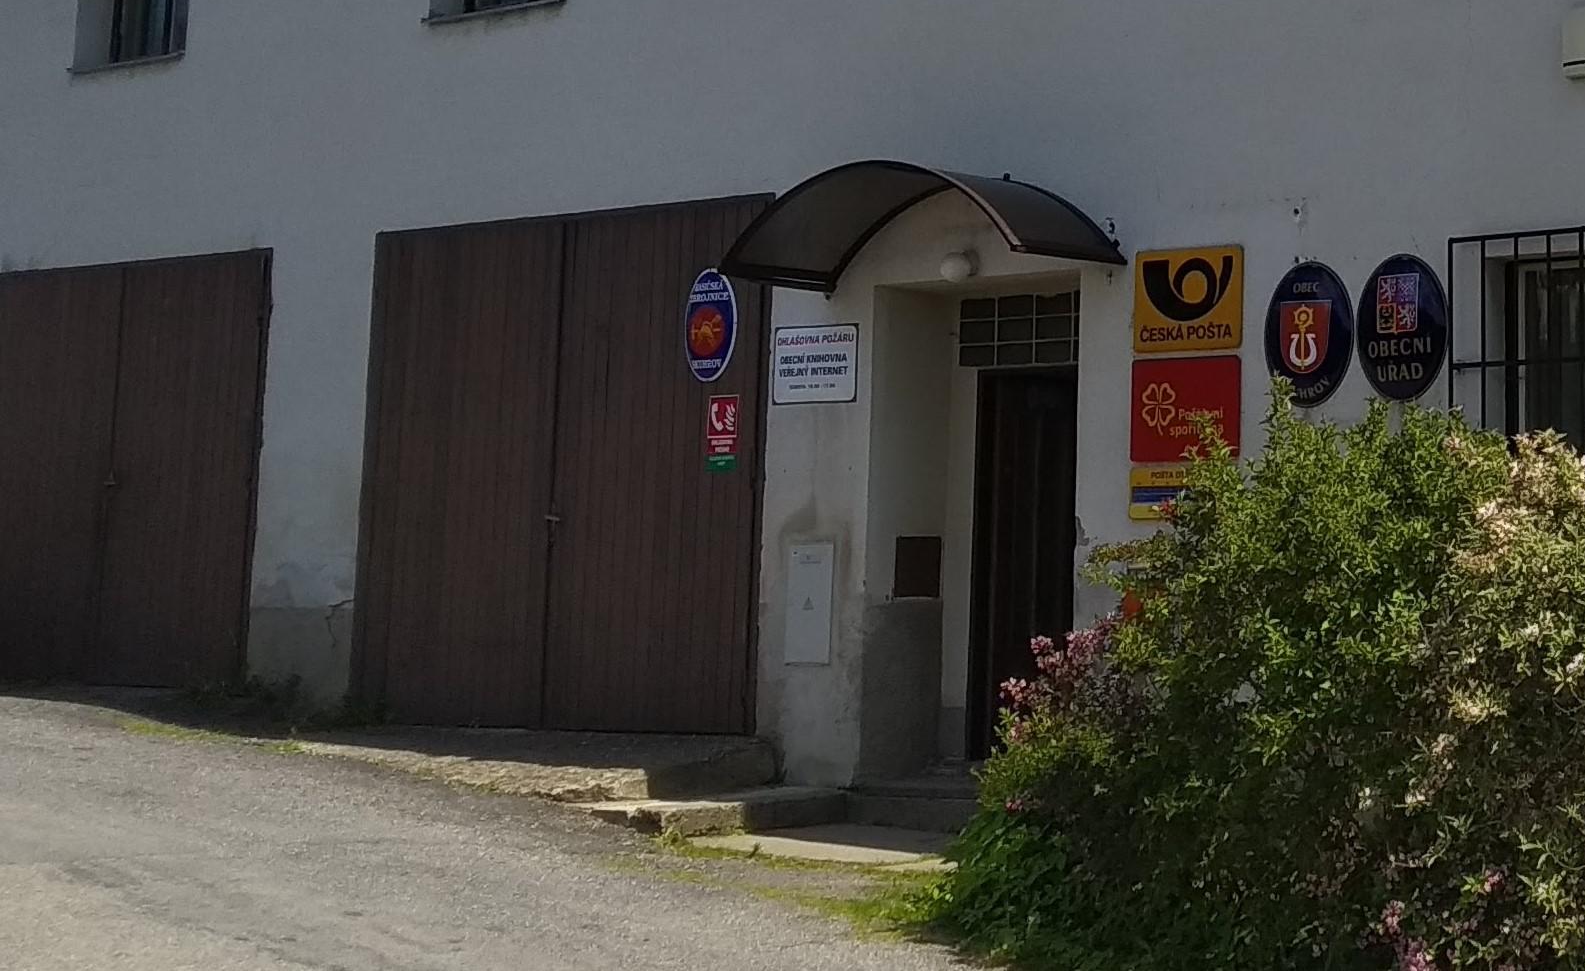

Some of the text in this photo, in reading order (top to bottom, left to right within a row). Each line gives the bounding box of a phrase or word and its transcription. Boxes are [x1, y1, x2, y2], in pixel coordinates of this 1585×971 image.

[1292, 281, 1320, 294] OBEC
[777, 331, 855, 347] OHLAŠOVNA POŽÁRU
[1139, 321, 1233, 343] ČESKÁ POŠTA
[1368, 333, 1432, 359] OBECNÍ
[780, 351, 848, 365] OBECNÍ KNIHOVNA
[778, 364, 849, 378] VEŘEJNÝ INTERNET
[1296, 375, 1330, 399] HROV
[1178, 406, 1224, 421] Pošní
